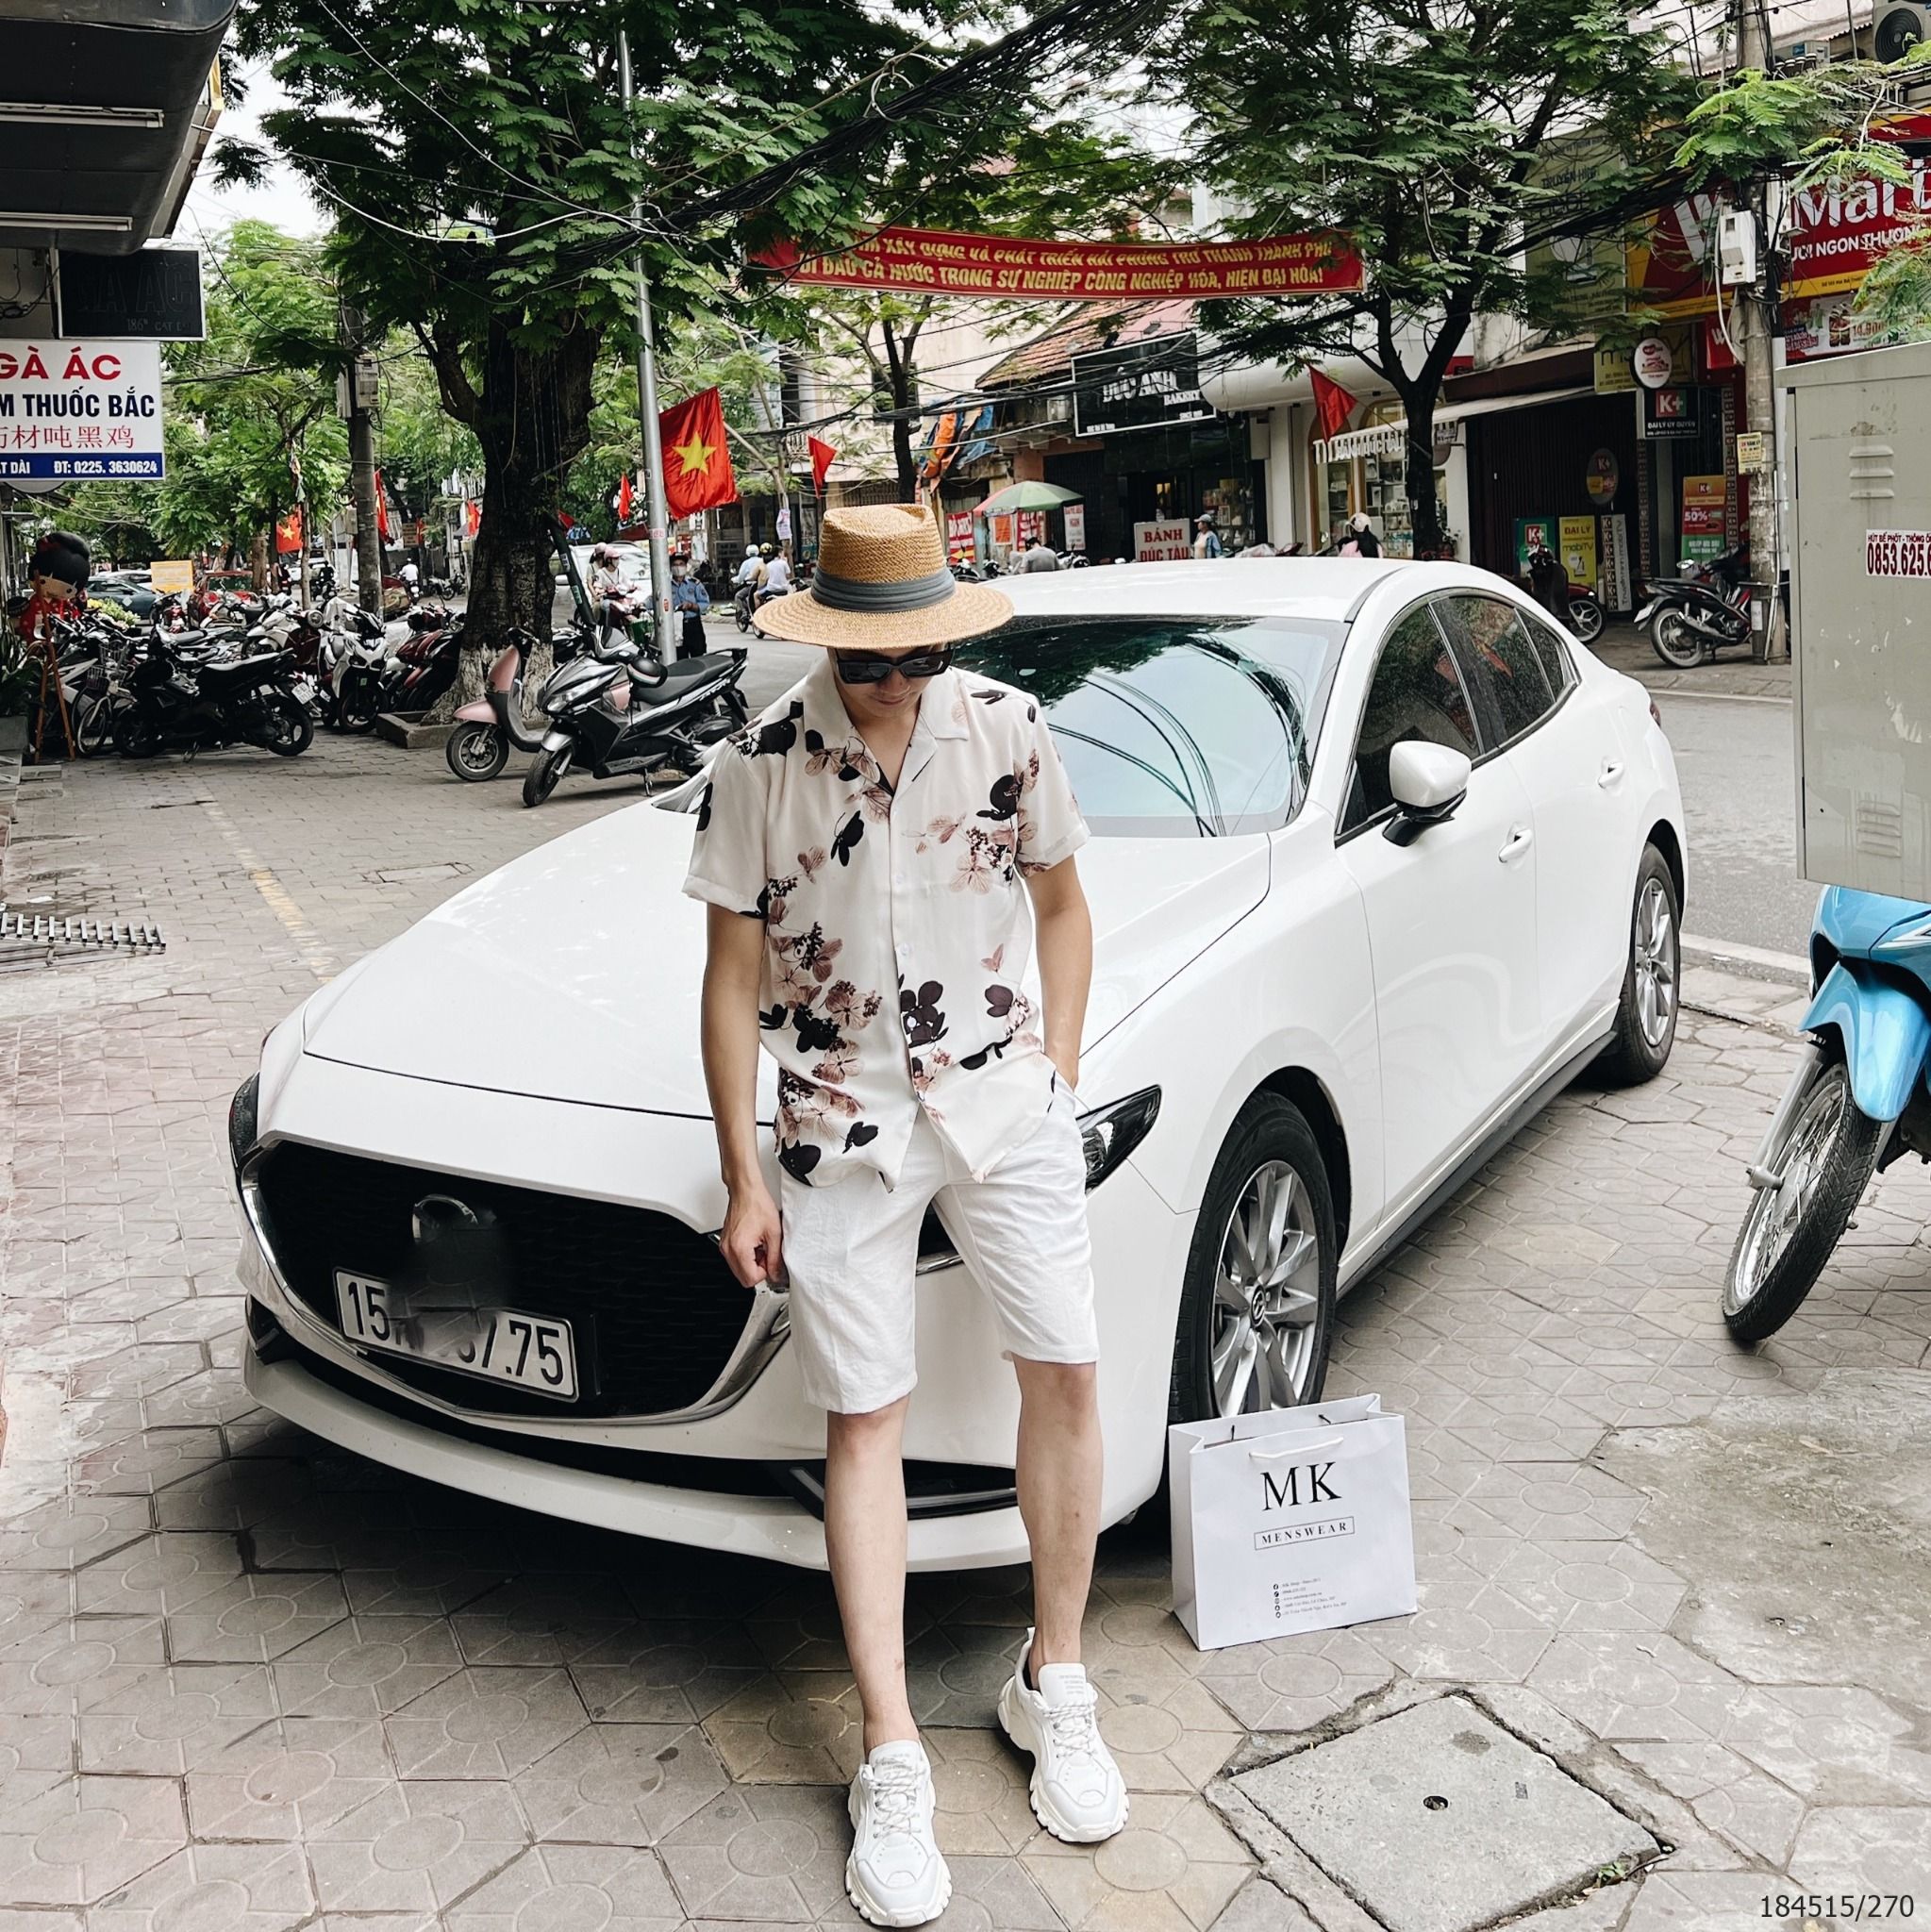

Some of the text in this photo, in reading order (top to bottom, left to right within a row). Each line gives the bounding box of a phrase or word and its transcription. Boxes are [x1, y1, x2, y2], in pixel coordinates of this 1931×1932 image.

[883, 237, 916, 256] XÂY
[920, 242, 966, 261] DỰNG
[993, 247, 1037, 265] PHÁT
[1040, 247, 1085, 266] TRIỂN
[1816, 236, 1859, 258] NGON
[862, 256, 885, 279] CẢ
[890, 260, 935, 284] NƯỚC
[939, 266, 993, 288] TRONG
[996, 269, 1023, 291] SỰ
[1023, 269, 1082, 293] NGHIỆP
[1085, 270, 1127, 291] CÔNG
[1130, 269, 1184, 293] NGHIỆP
[1225, 267, 1260, 290] HIỆN
[1262, 268, 1287, 289] ĐẠI
[62, 345, 122, 381] ÁC
[23, 386, 100, 418] THUỐC
[108, 386, 155, 418] BẮC
[10, 459, 30, 475] DÀI
[54, 460, 72, 475] ĐT:
[75, 460, 106, 474] 0225.
[108, 460, 158, 474] 3630624
[1143, 527, 1183, 543] BÁNH
[1260, 1461, 1342, 1511] MK
[1261, 1522, 1347, 1544] MENSWEAR
